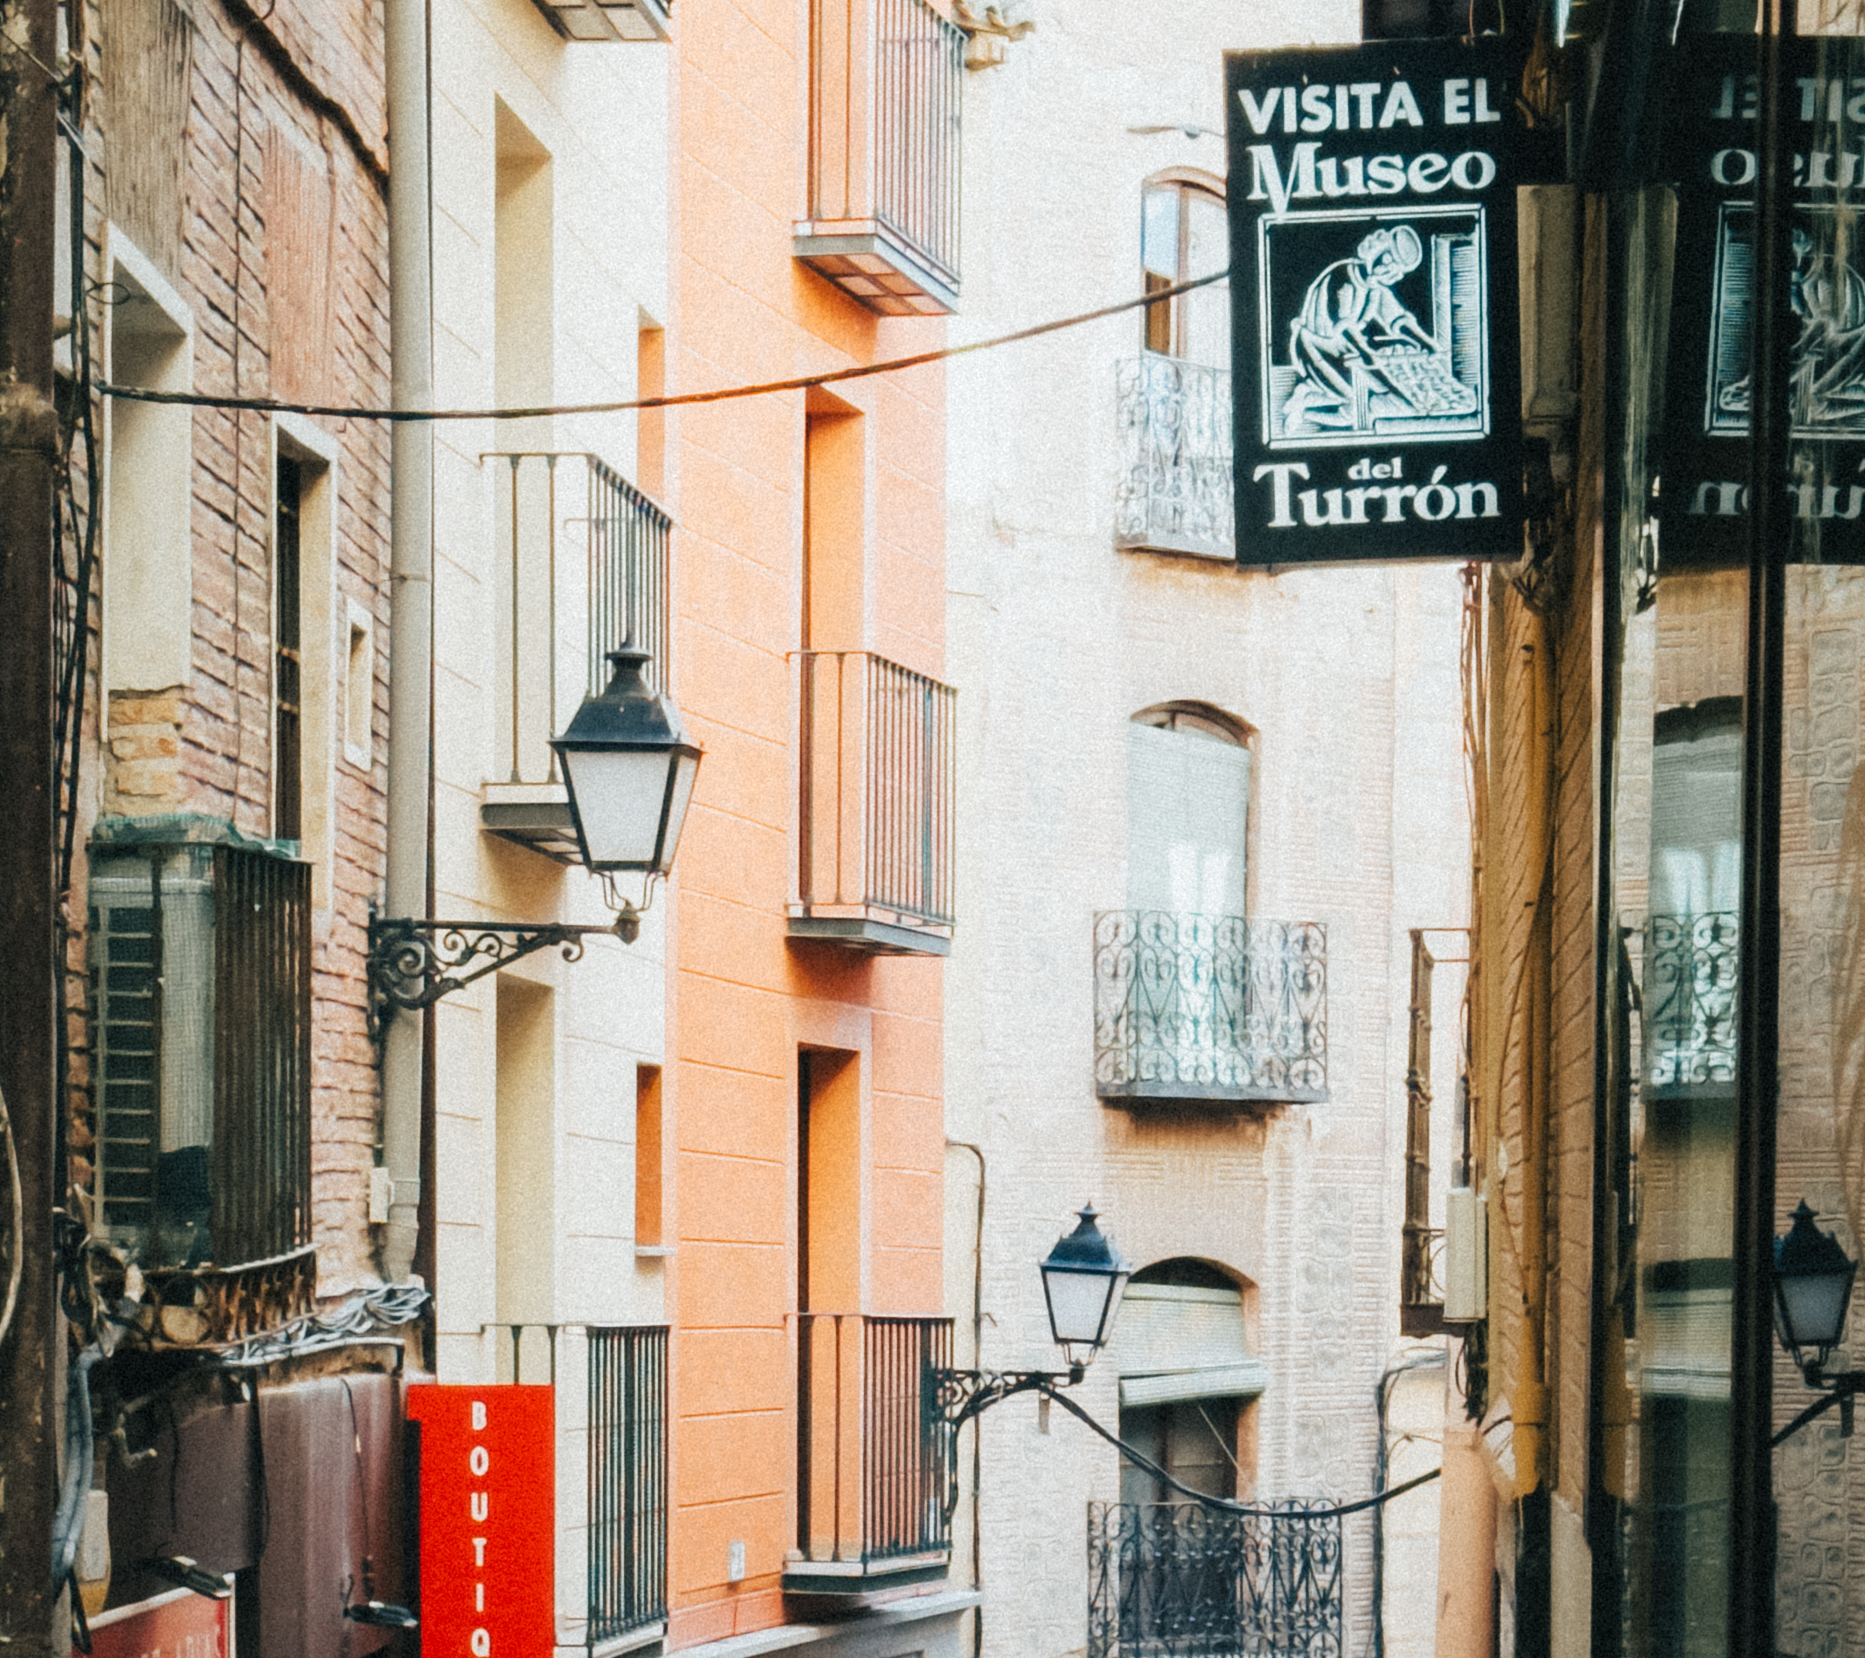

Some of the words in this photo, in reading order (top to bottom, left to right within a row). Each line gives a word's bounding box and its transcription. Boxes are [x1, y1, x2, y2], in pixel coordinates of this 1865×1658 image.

[1239, 82, 1424, 135] VISITA
[1444, 78, 1501, 125] EL
[1246, 141, 1497, 222] Museo
[1253, 464, 1501, 528] Turrón
[1348, 457, 1403, 481] del
